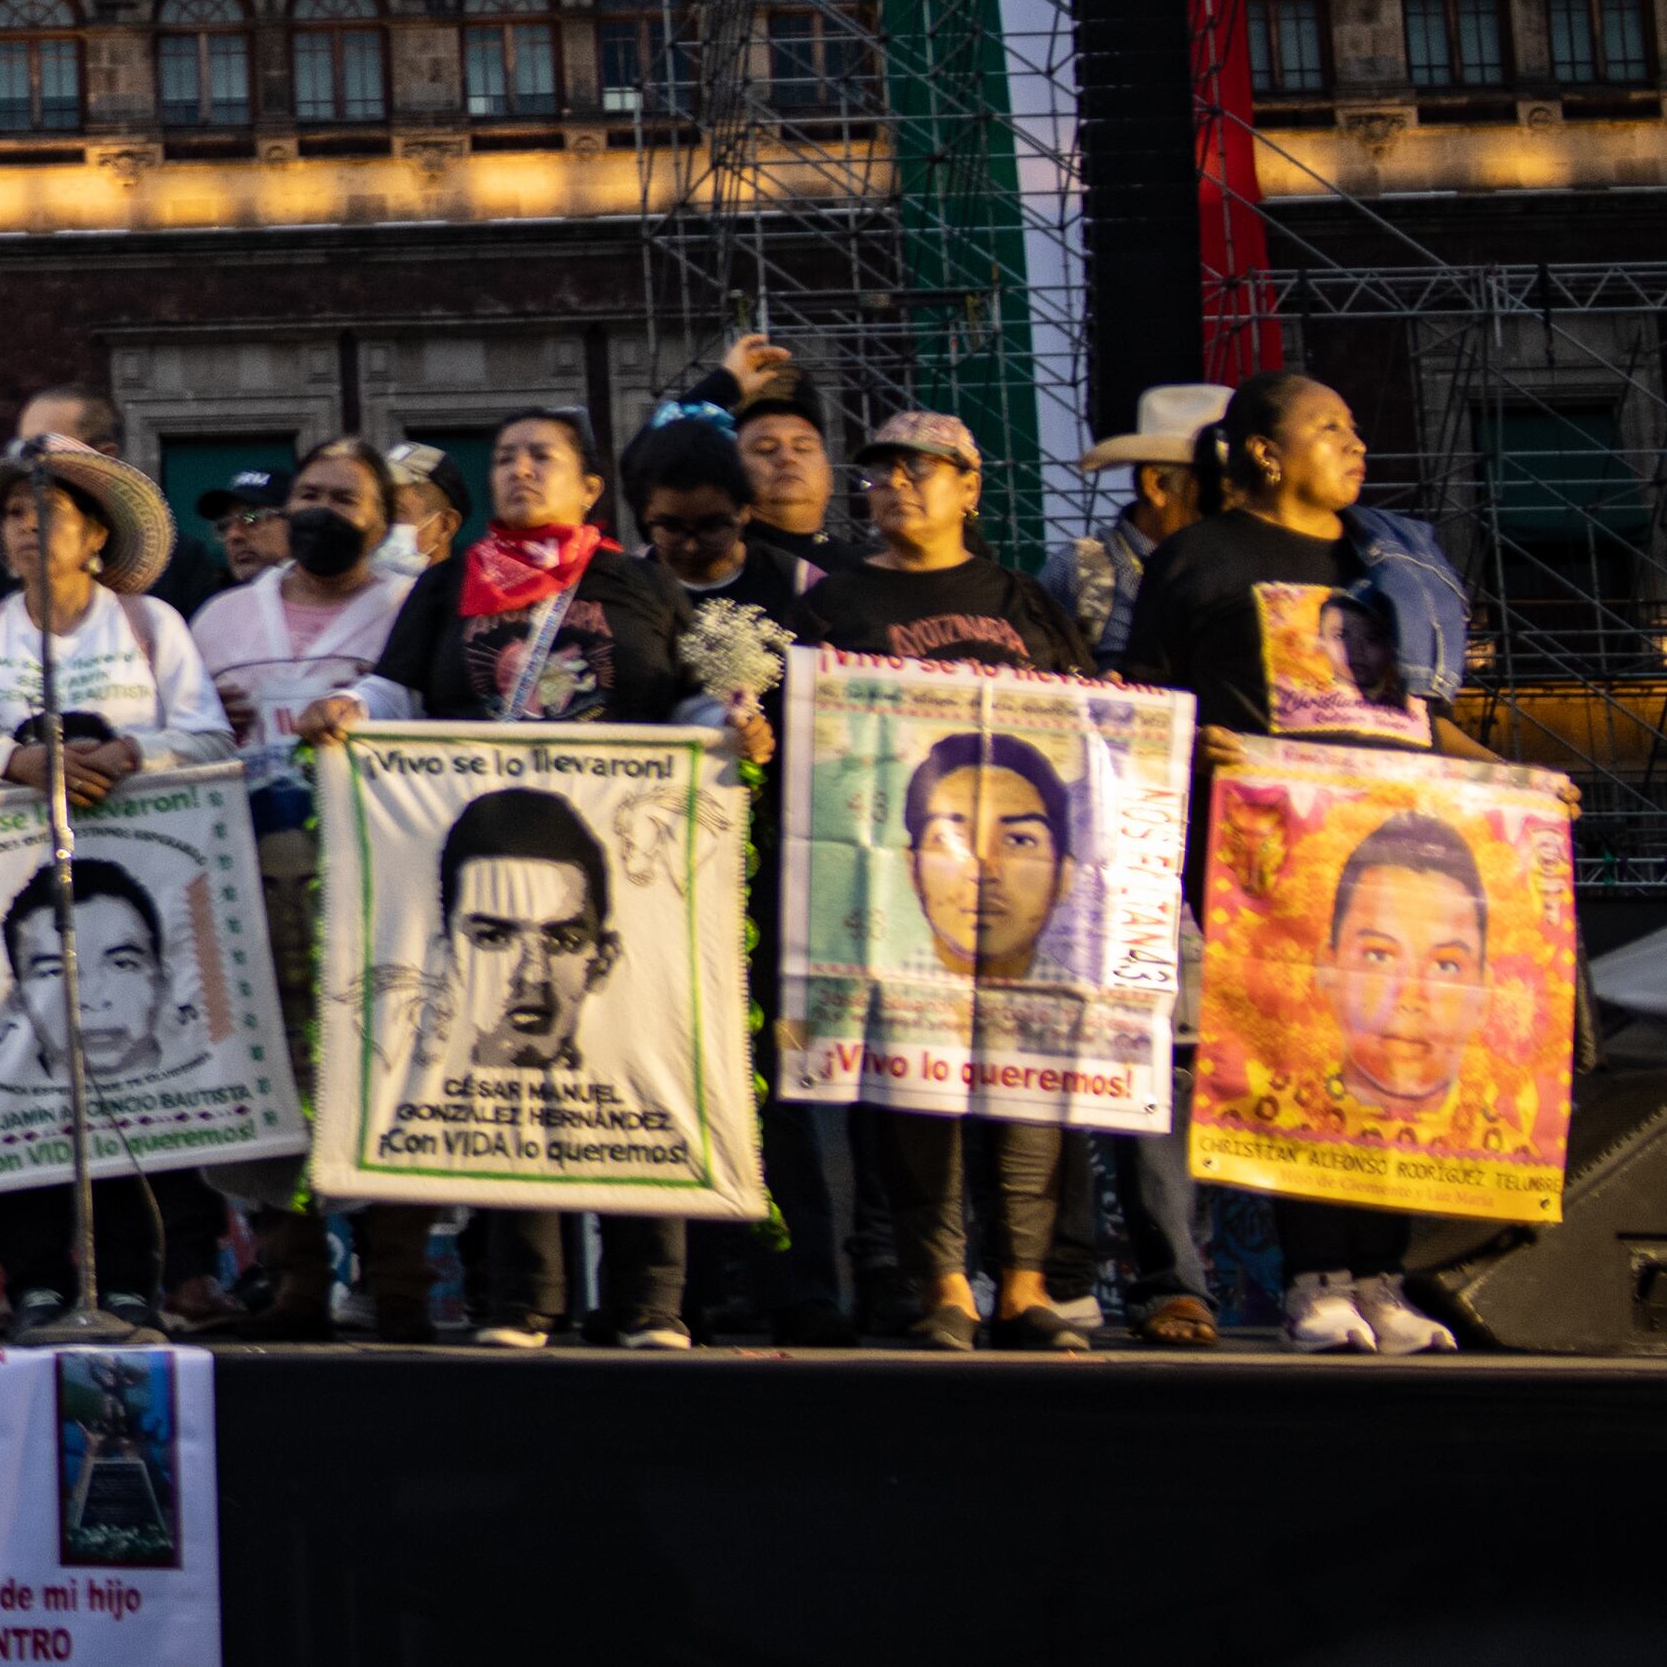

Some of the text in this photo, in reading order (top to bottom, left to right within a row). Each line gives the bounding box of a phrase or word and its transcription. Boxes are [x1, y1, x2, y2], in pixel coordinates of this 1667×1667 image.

[367, 748, 674, 779] ¡Vivo se lo llevaron!
[444, 1074, 625, 1104] CÉSAR MANUEL
[822, 1043, 1134, 1099] ¡Vivo lo queremos!
[159, 1084, 253, 1109] BAUTISTA
[25, 1141, 73, 1170] VID
[92, 1135, 120, 1157] lo
[129, 1118, 257, 1158] queremos!
[379, 1127, 689, 1167] ¡Con VIDA lo queremos!
[1200, 1134, 1298, 1164] CHRISTIAN
[1308, 1150, 1387, 1175] ALFONSO
[1495, 1171, 1563, 1196] TELUMBRE
[0, 1579, 34, 1613] de
[46, 1578, 79, 1614] mi
[87, 1578, 143, 1622] hijo
